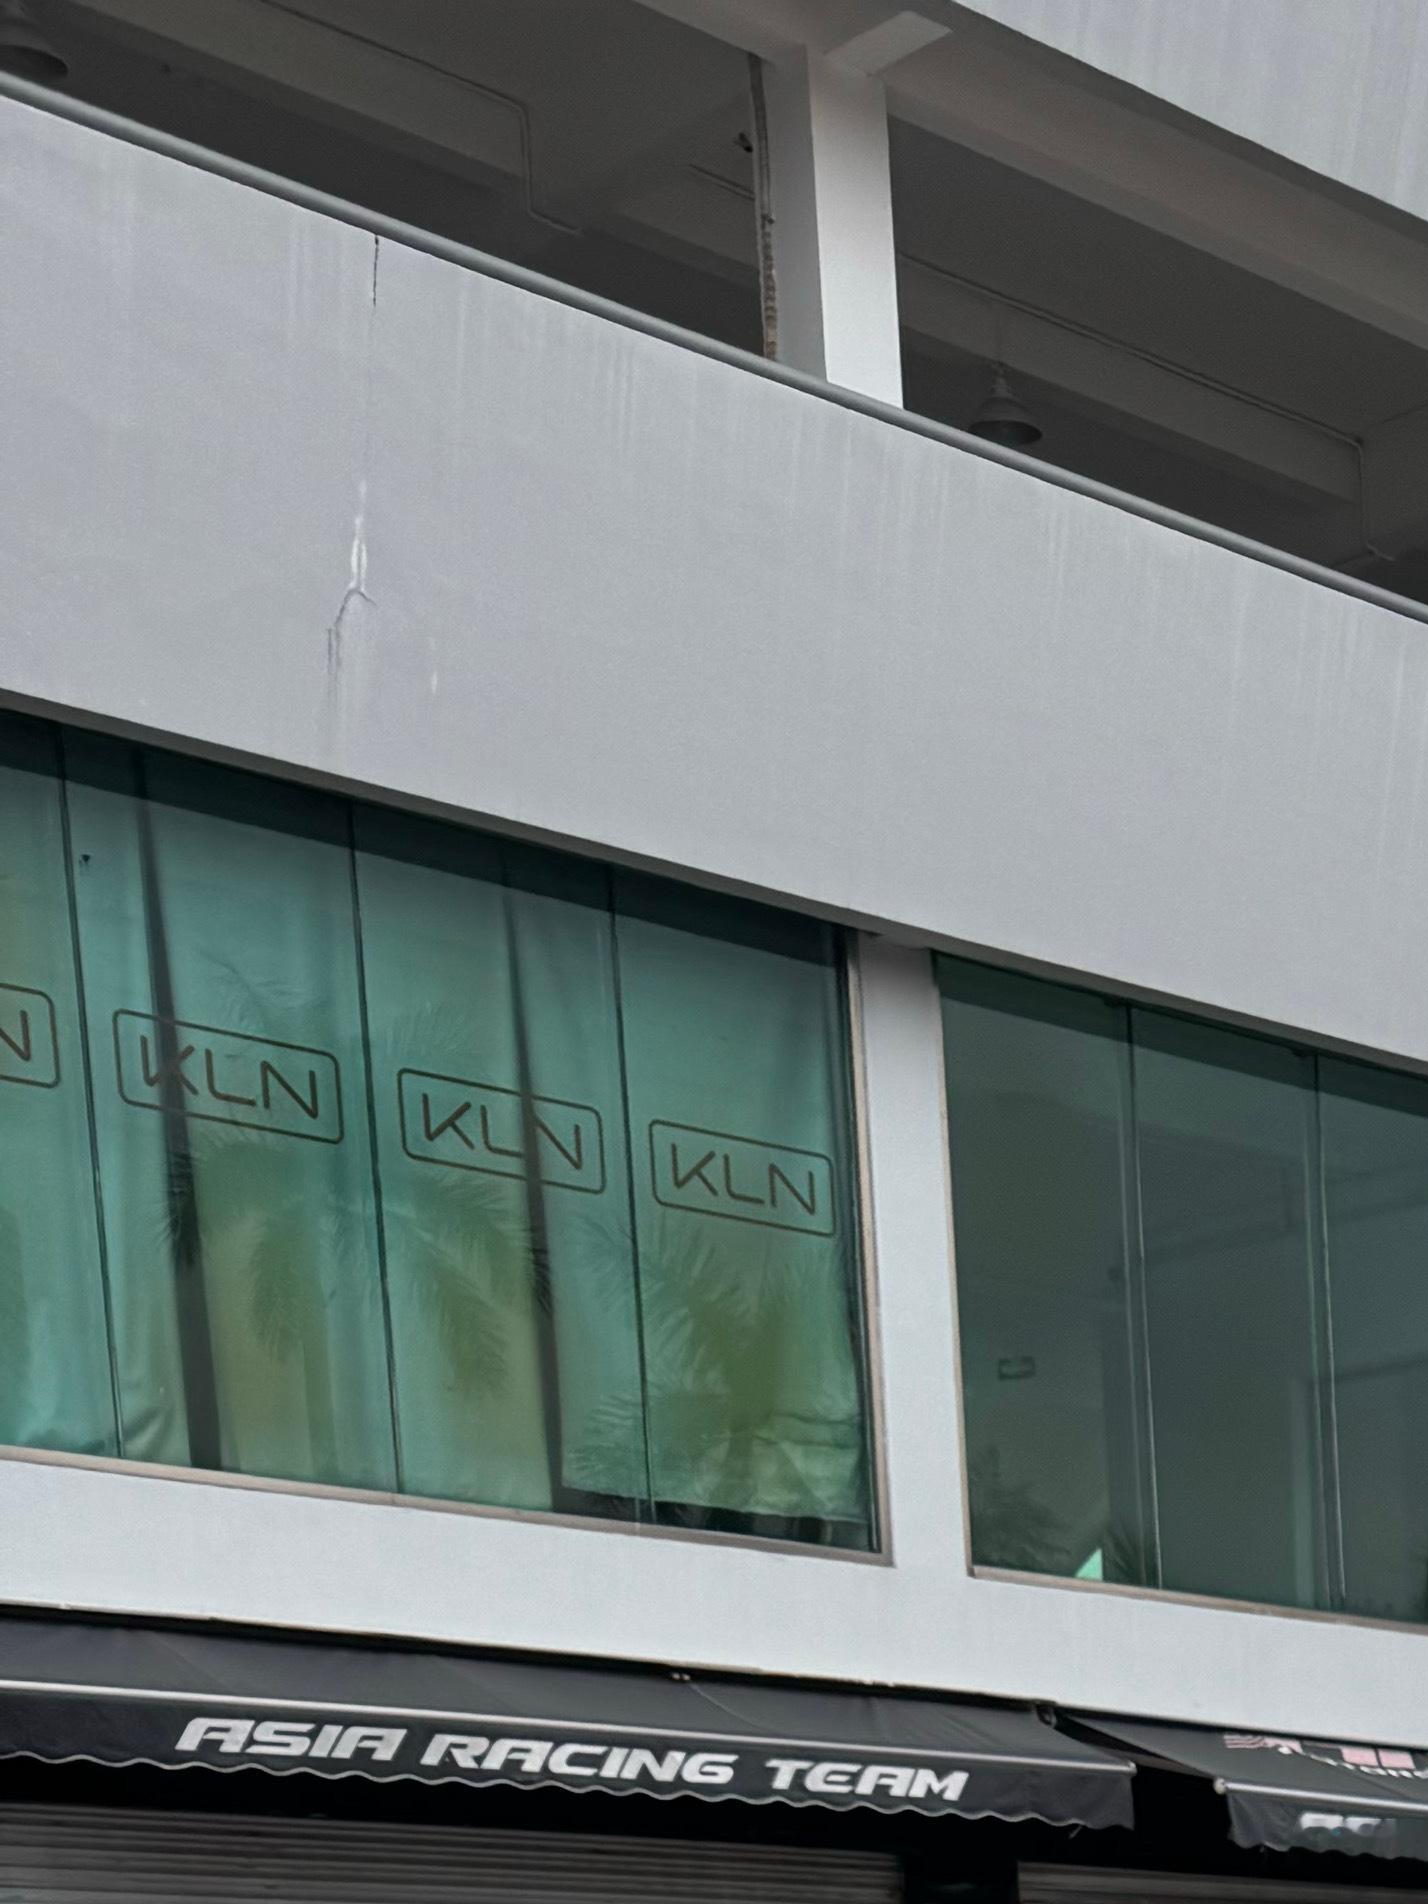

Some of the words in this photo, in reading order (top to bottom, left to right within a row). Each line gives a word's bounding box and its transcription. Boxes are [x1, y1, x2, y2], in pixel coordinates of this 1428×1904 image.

[139, 1036, 318, 1118] KLN
[422, 1093, 583, 1169] KLN
[671, 1143, 815, 1215] KLN
[174, 1718, 407, 1760] ASIA
[421, 1734, 739, 1785] RACING
[765, 1757, 968, 1801] TEAM
